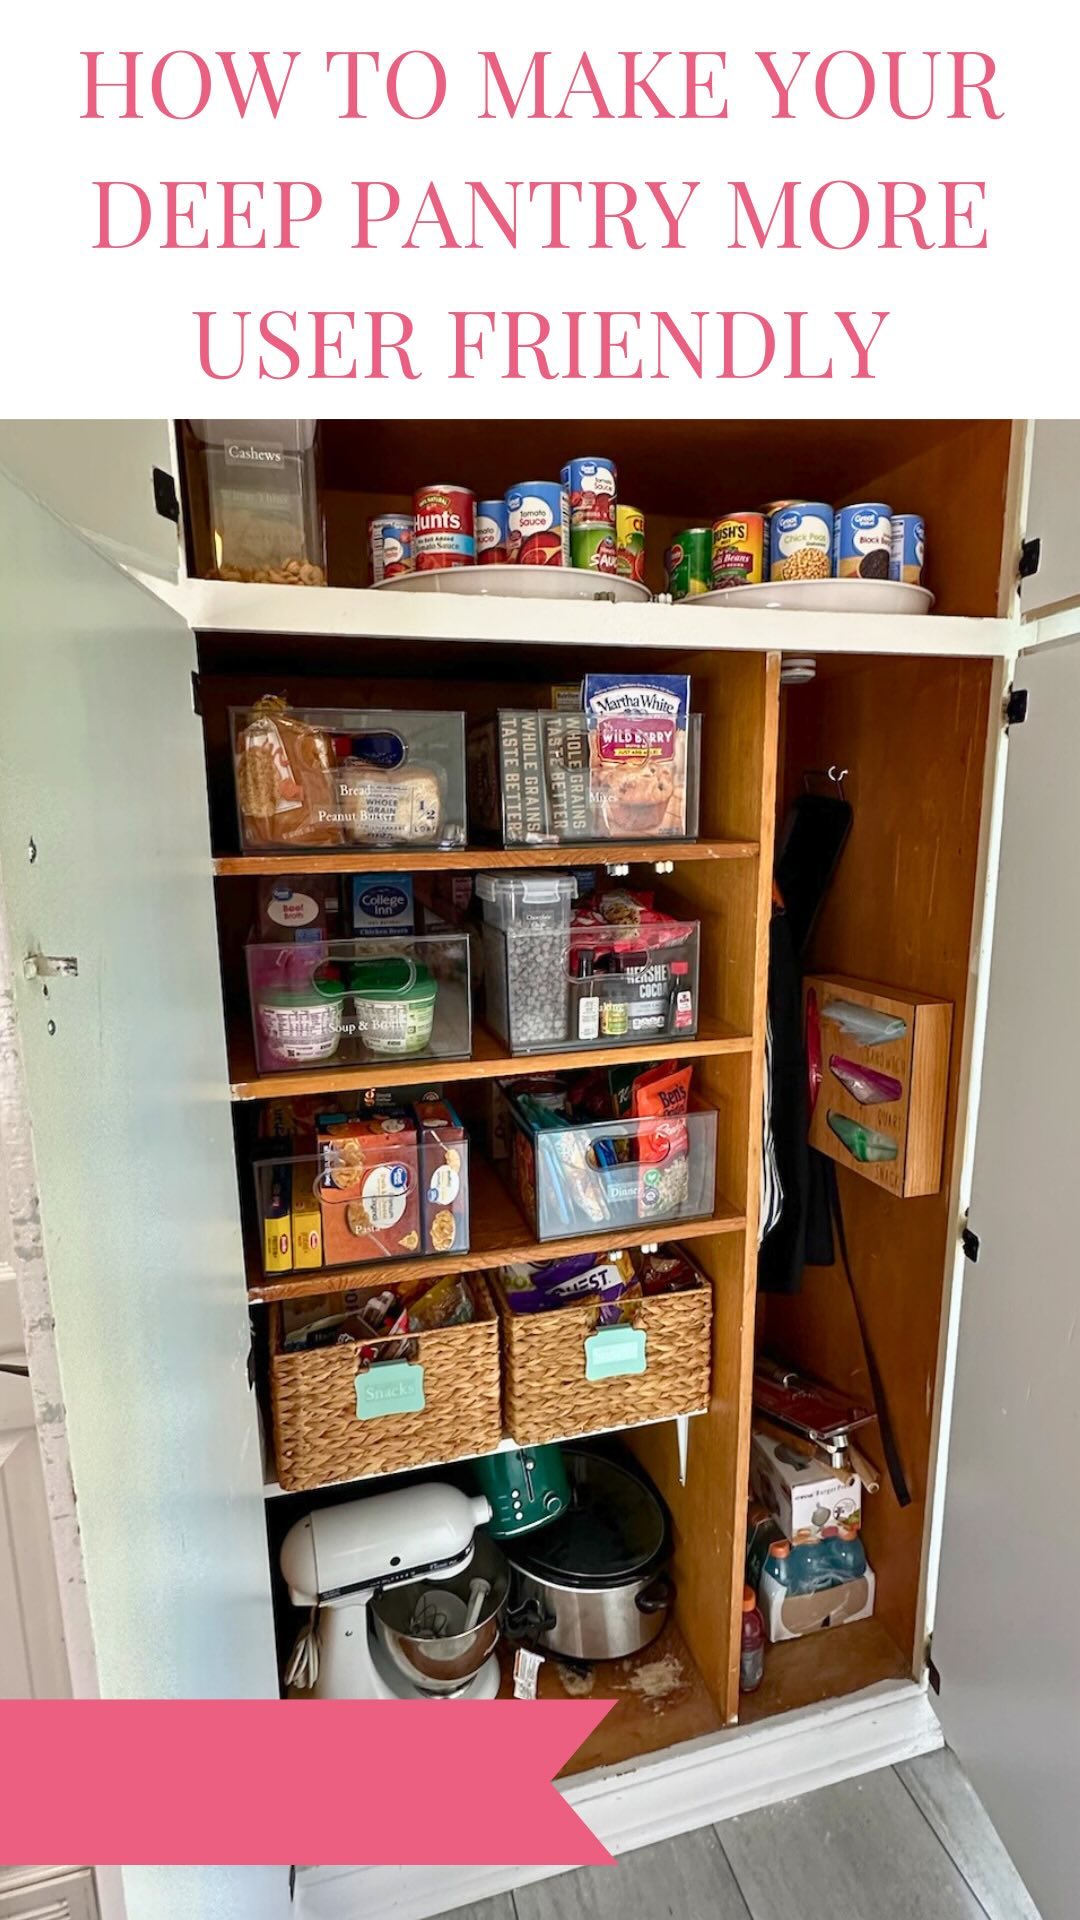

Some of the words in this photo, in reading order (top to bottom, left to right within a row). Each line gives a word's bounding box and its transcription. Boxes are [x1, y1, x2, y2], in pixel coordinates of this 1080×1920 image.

[228, 445, 281, 462] Cashews
[519, 517, 547, 528] Sauce
[597, 694, 639, 715] Martha
[640, 693, 675, 714] White
[502, 717, 519, 768] TASTE
[520, 716, 539, 771] WHOLE
[547, 717, 564, 767] TASTE
[566, 715, 582, 770] WHOLE
[602, 730, 633, 744] WILD
[339, 784, 372, 797] Bread
[366, 798, 398, 807] WHOLE
[505, 773, 523, 833] BETTER
[524, 776, 541, 832] GRAINS
[551, 771, 569, 830] BETTER
[570, 774, 586, 829] GRAINS
[318, 810, 356, 823] Peanut
[367, 806, 396, 815] GRAIN
[362, 893, 406, 908] College
[374, 905, 393, 916] Inn
[328, 1021, 356, 1035] Soup
[357, 1020, 369, 1031] &
[658, 1085, 687, 1108] Ben's
[355, 1224, 381, 1235] Pasta
[366, 1381, 415, 1401] Snacks
